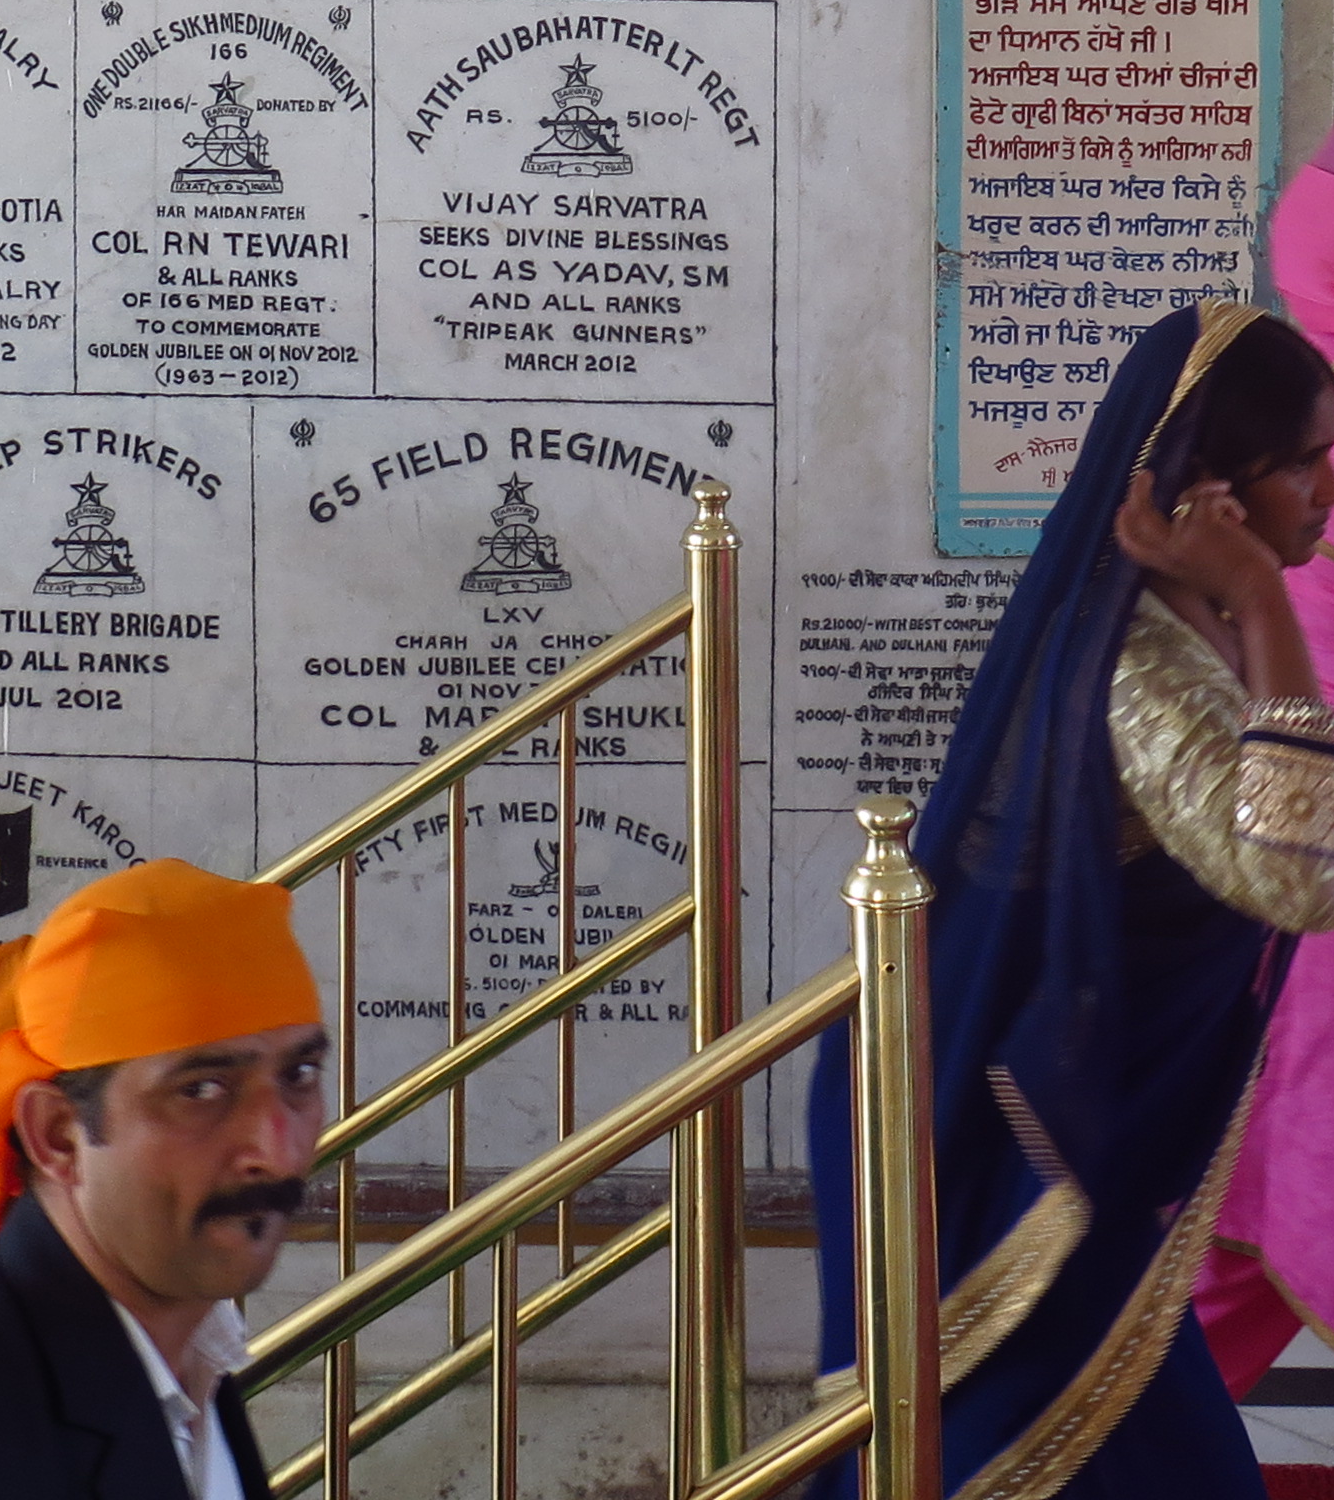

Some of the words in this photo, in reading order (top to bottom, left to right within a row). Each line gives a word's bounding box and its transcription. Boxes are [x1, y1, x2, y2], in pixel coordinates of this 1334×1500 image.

[211, 43, 247, 60] 166
[443, 192, 539, 215] VIJAY
[554, 195, 707, 220] SARVATRA
[505, 353, 578, 371] MARCH
[585, 355, 636, 372] 2012
[44, 428, 222, 500] STRIKERS
[484, 607, 544, 623] LXV
[111, 613, 219, 639] BRIGADE
[860, 638, 886, 651] AND
[305, 657, 405, 676] GOLDEN
[418, 657, 515, 676] JUBILEE
